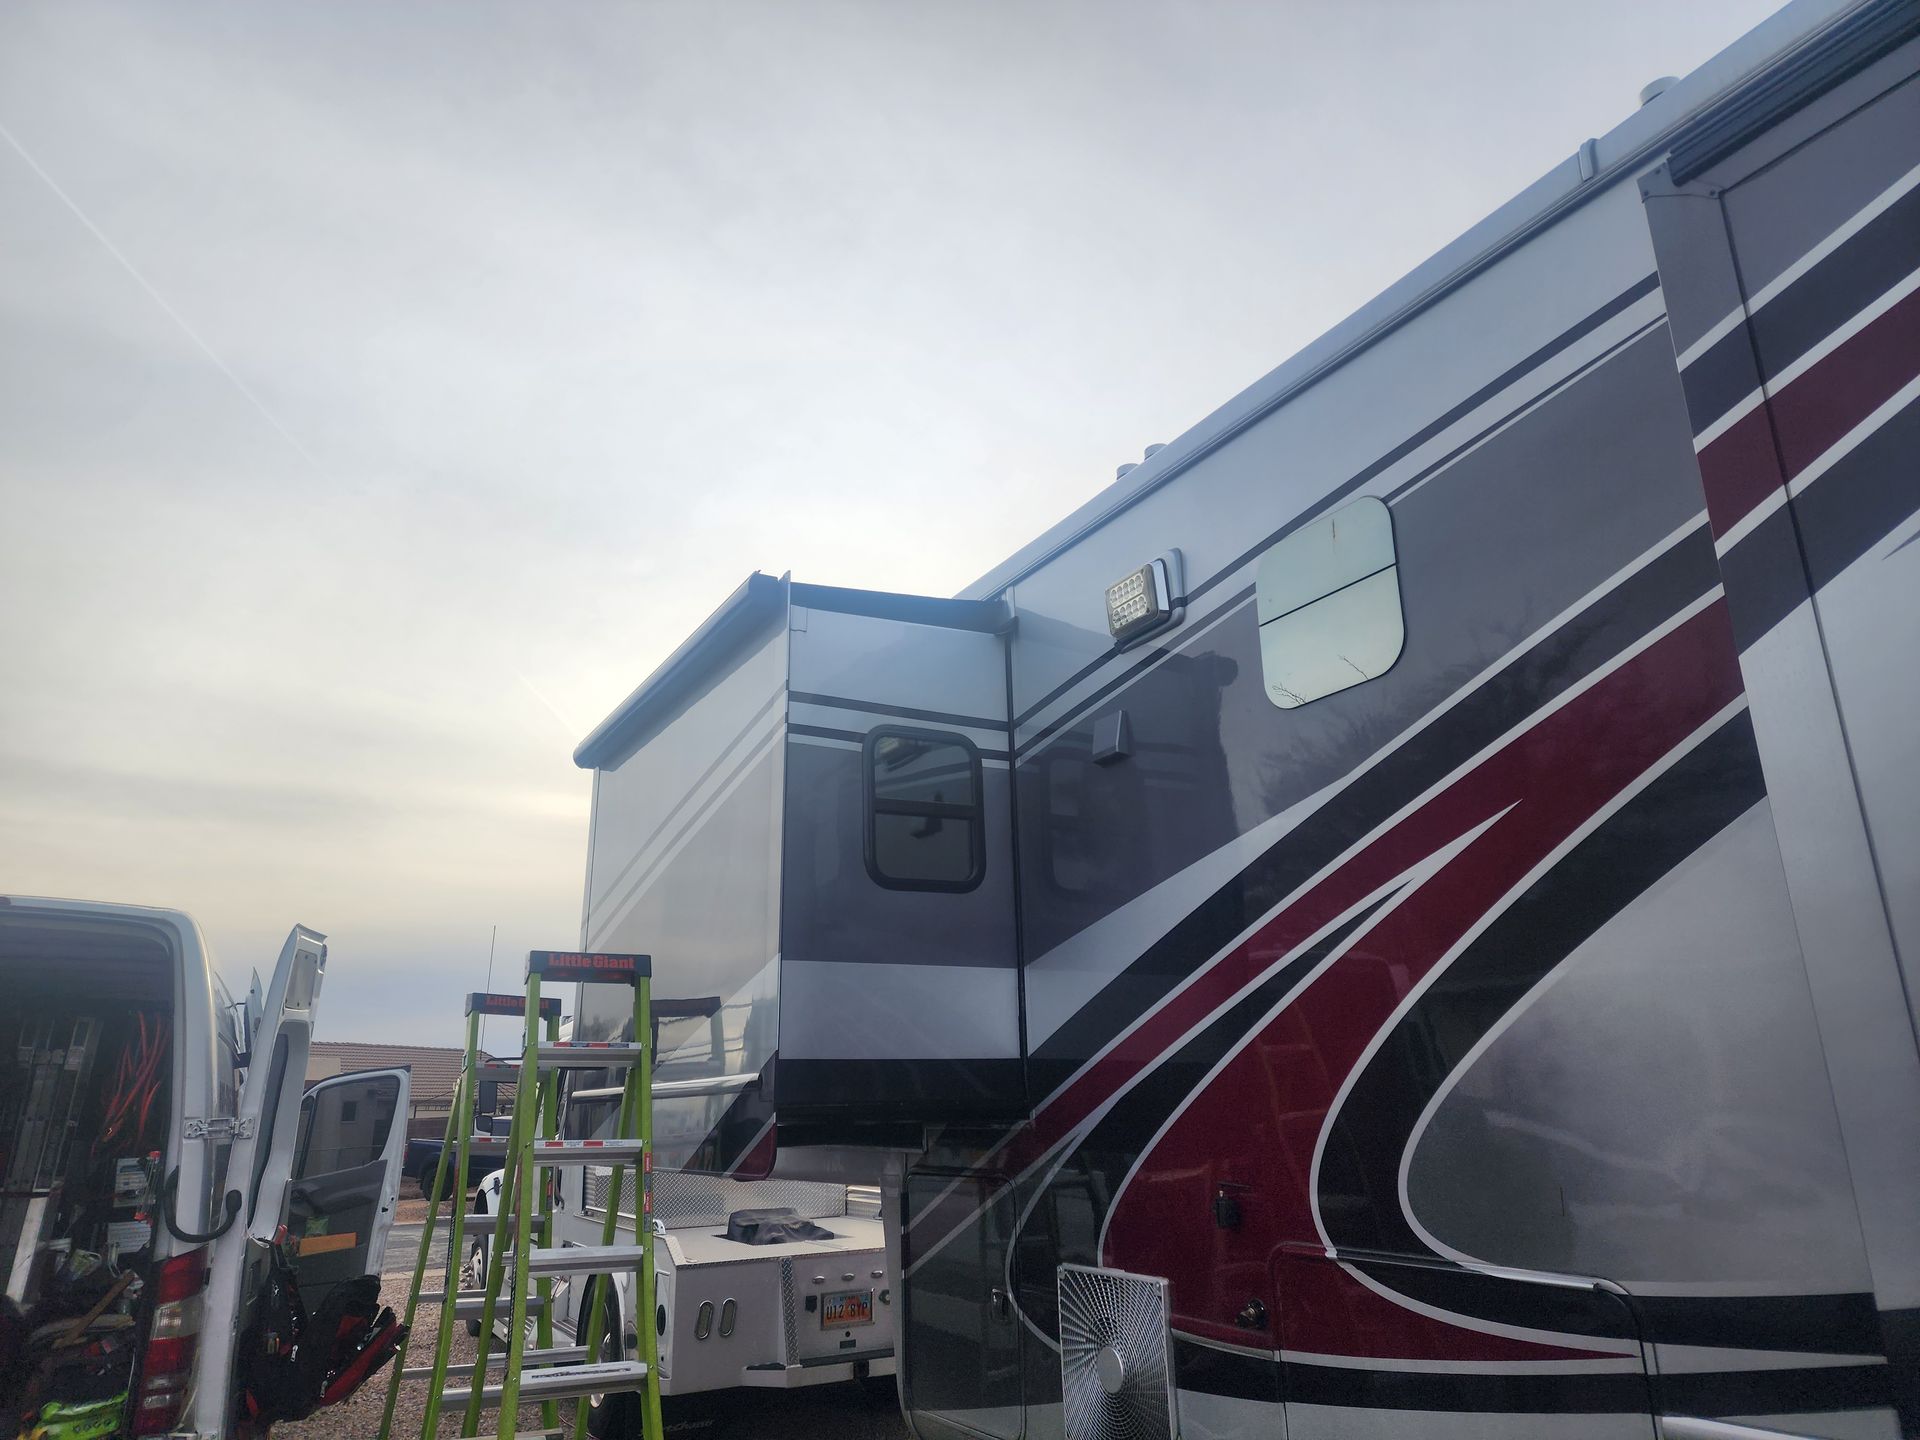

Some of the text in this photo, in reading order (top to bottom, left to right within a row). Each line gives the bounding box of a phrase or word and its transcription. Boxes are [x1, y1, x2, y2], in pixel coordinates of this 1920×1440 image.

[549, 953, 635, 968] Little Giant
[486, 995, 518, 1007] Little
